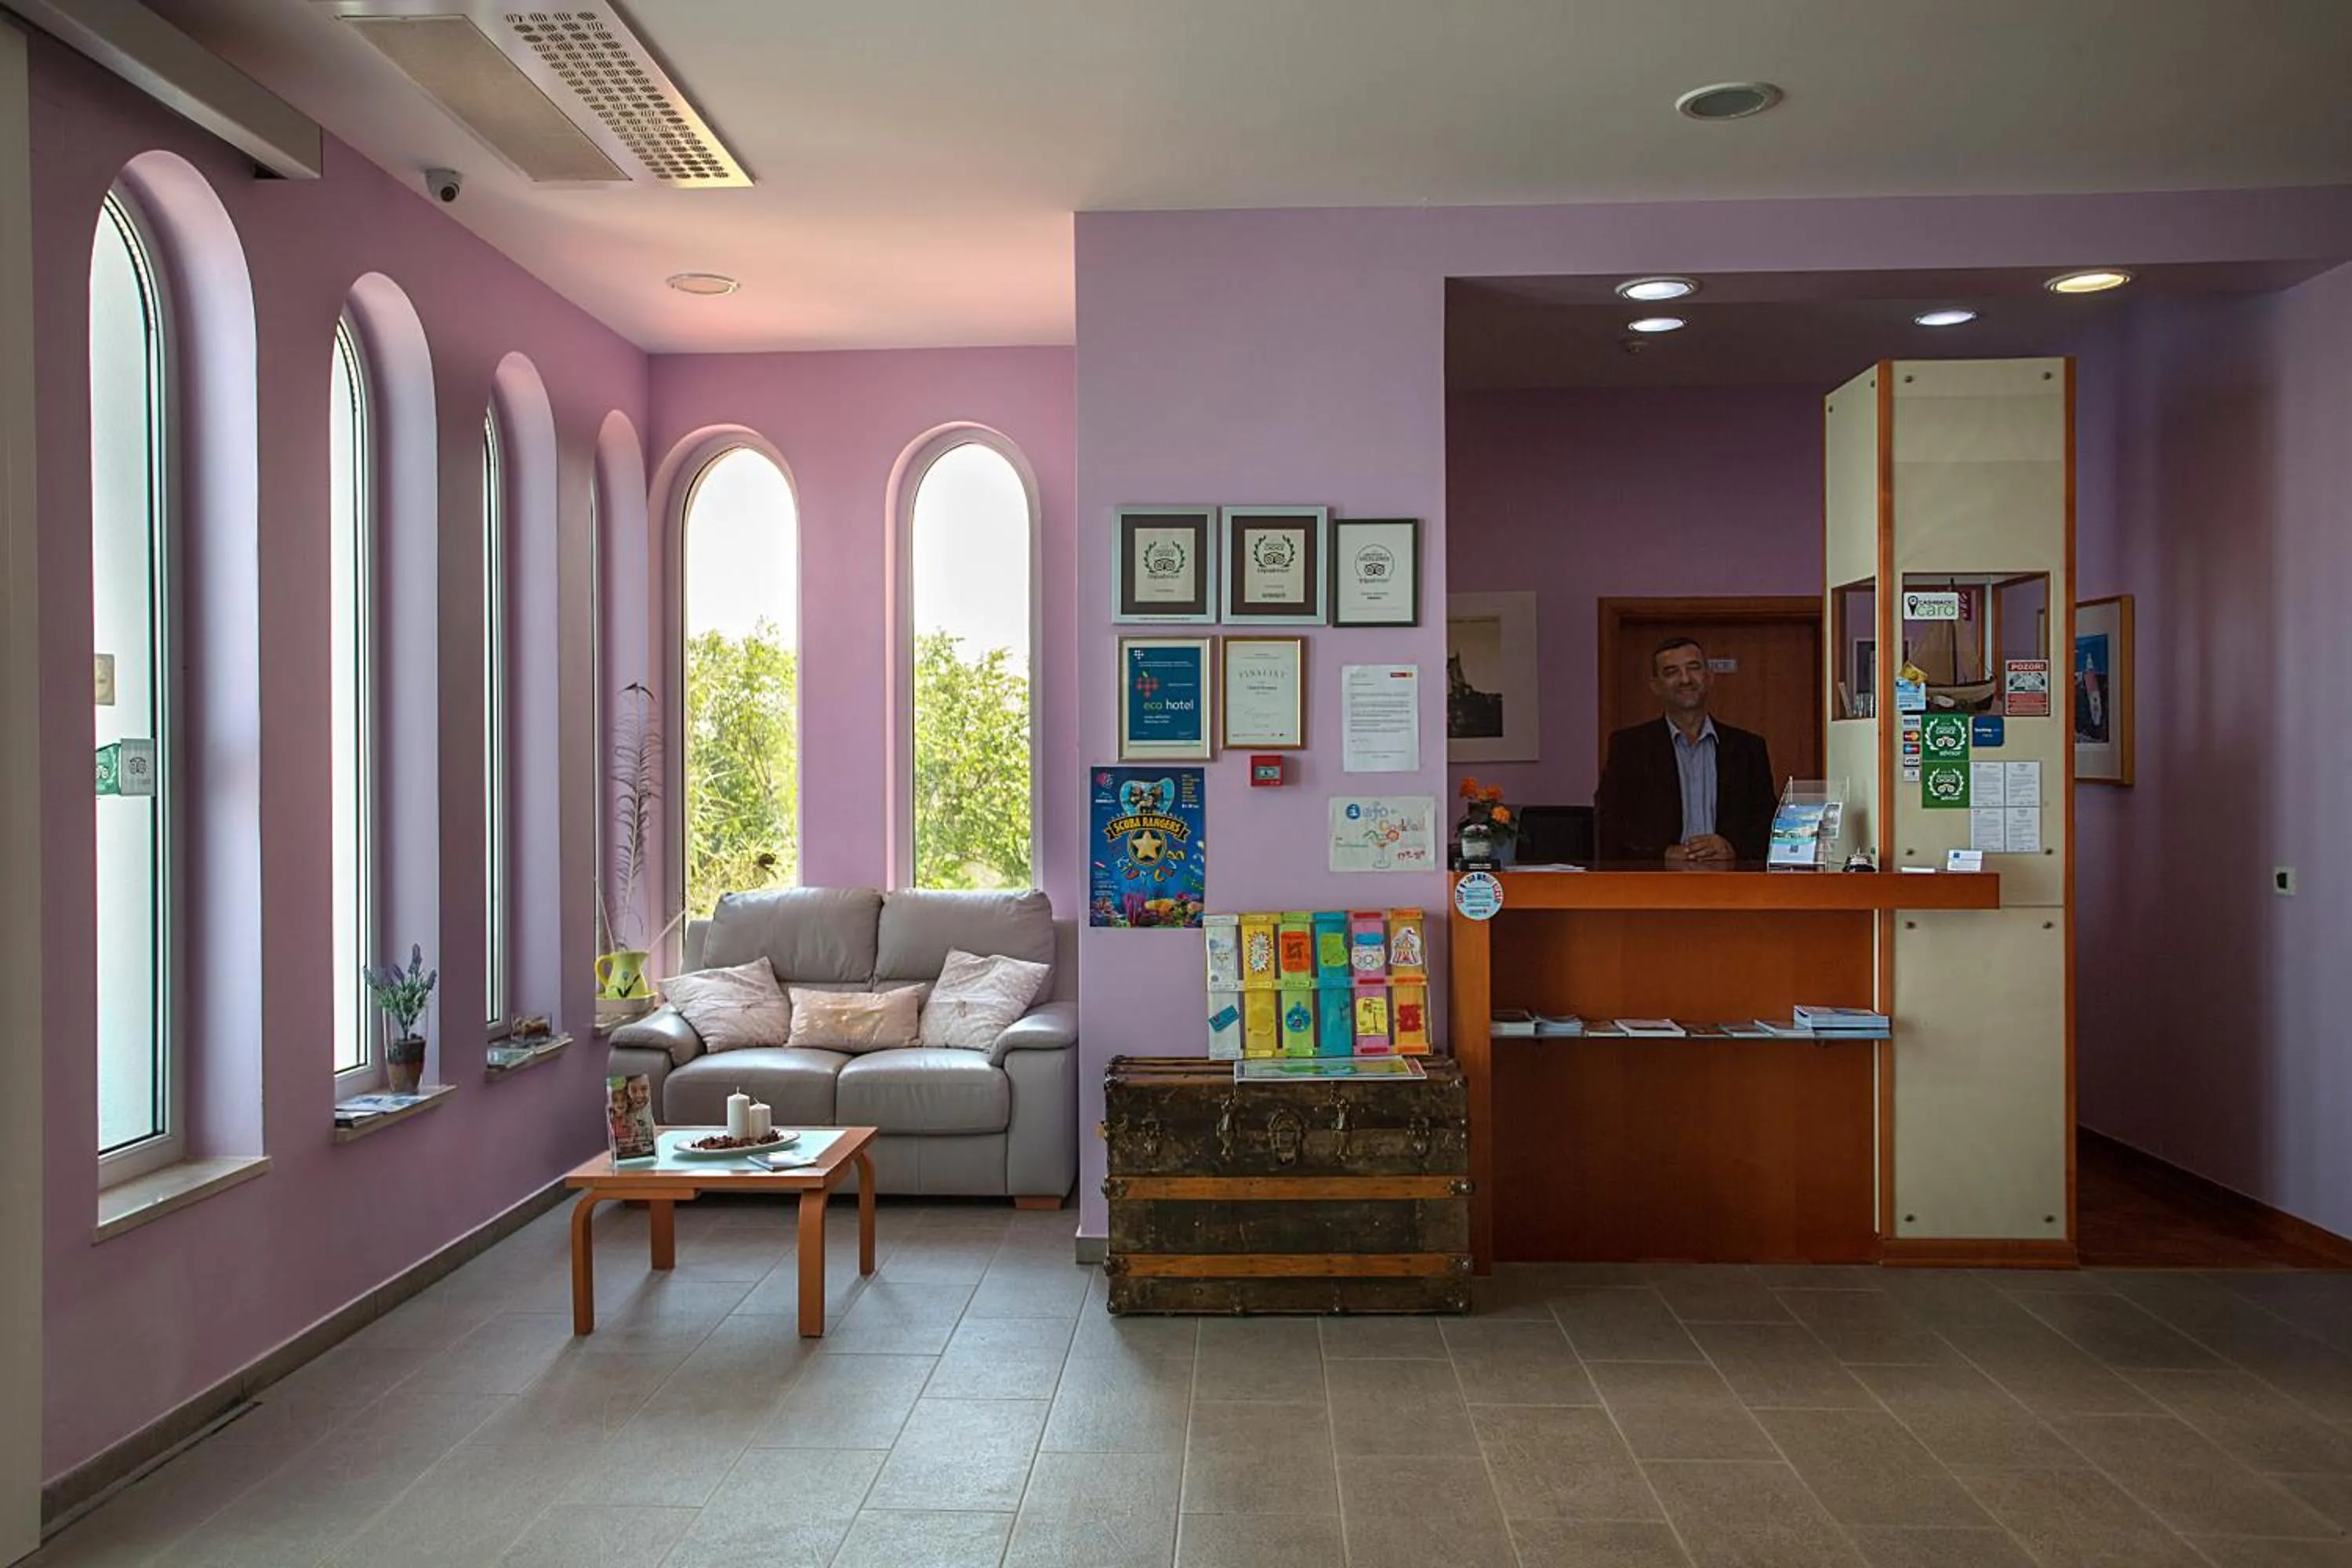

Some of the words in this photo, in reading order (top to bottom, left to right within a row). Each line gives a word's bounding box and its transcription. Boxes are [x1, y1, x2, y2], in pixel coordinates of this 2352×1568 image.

[1916, 604, 1955, 617] card
[1143, 702, 1163, 710] eco
[1166, 698, 1195, 710] hotel
[1112, 816, 1141, 833] SCUBA
[1142, 816, 1181, 833] RANGERS
